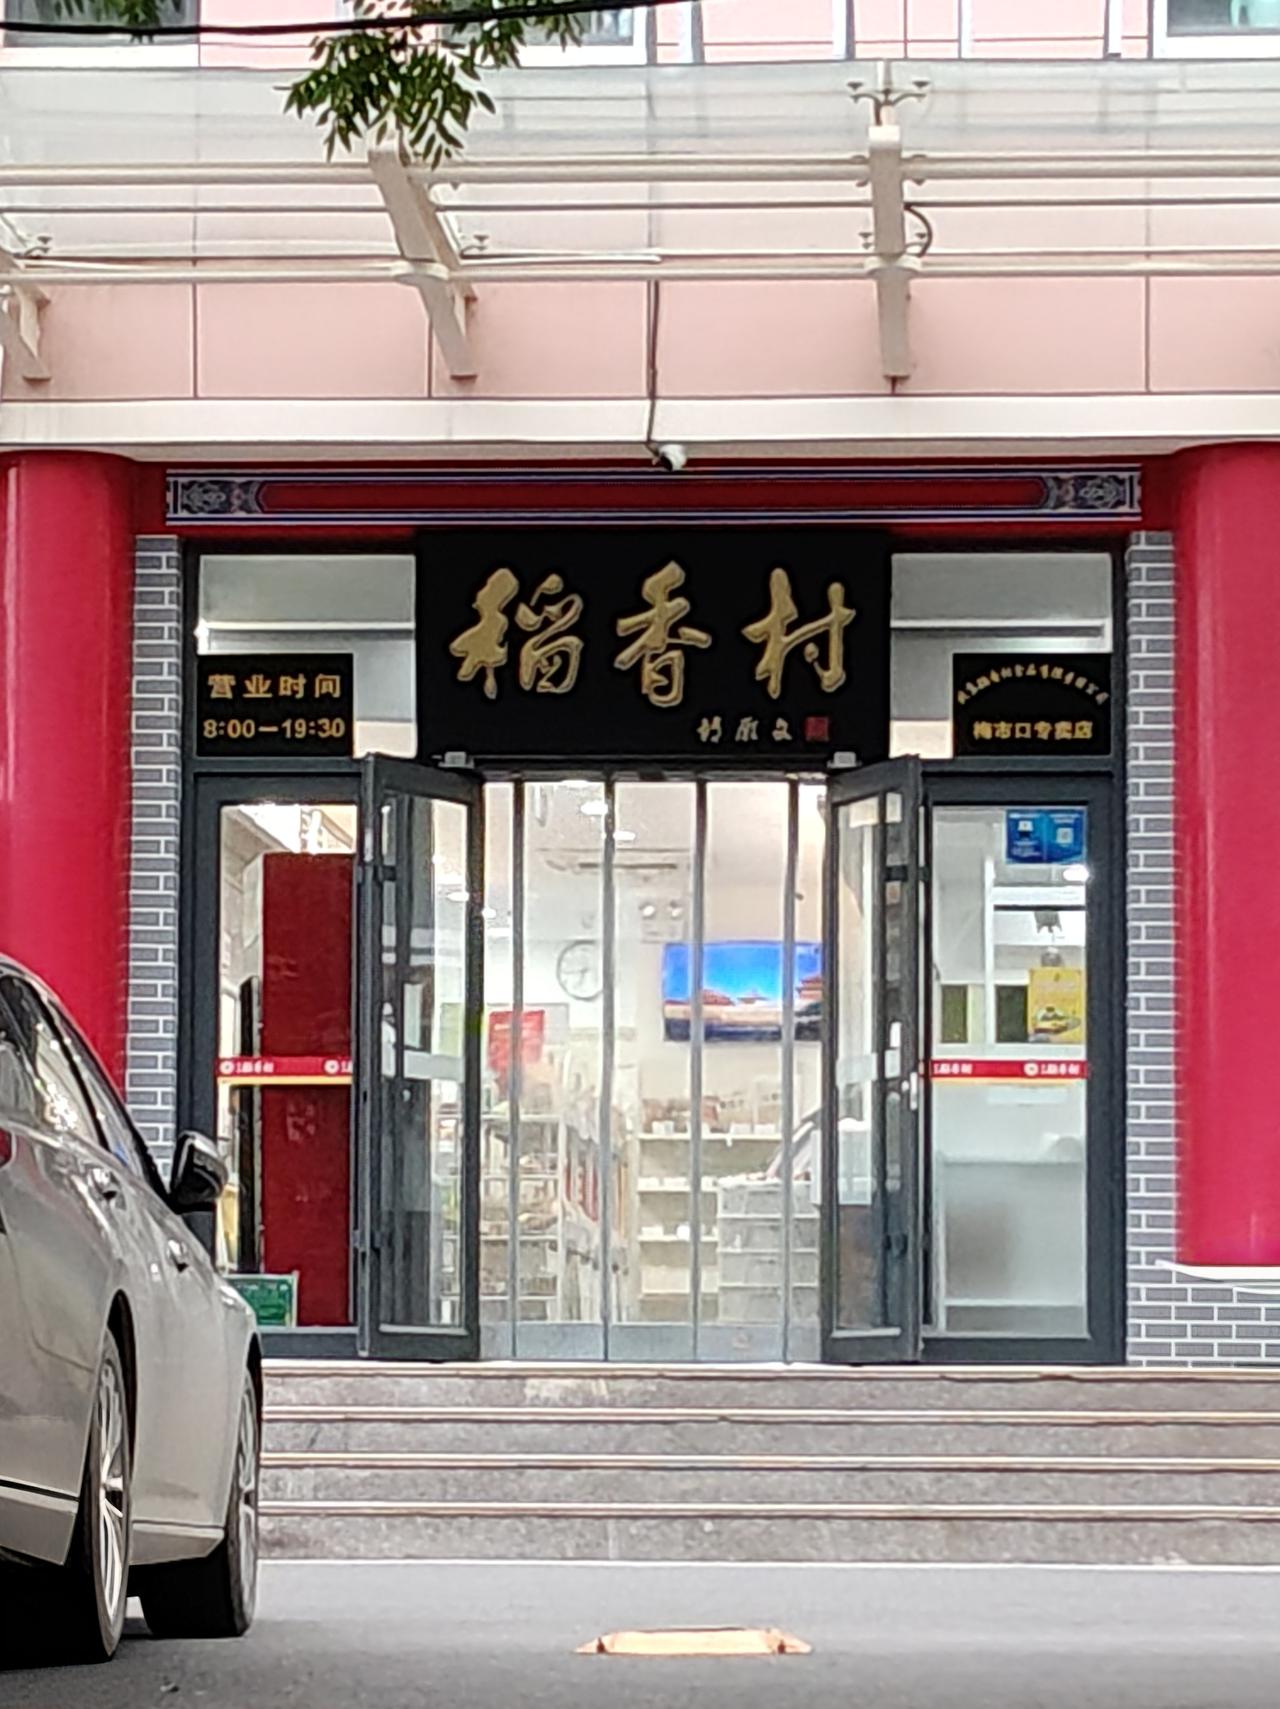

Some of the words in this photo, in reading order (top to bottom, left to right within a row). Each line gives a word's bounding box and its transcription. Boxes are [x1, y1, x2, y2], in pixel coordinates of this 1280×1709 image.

[450, 561, 857, 708] 稻香村
[207, 672, 342, 700] 营业时间
